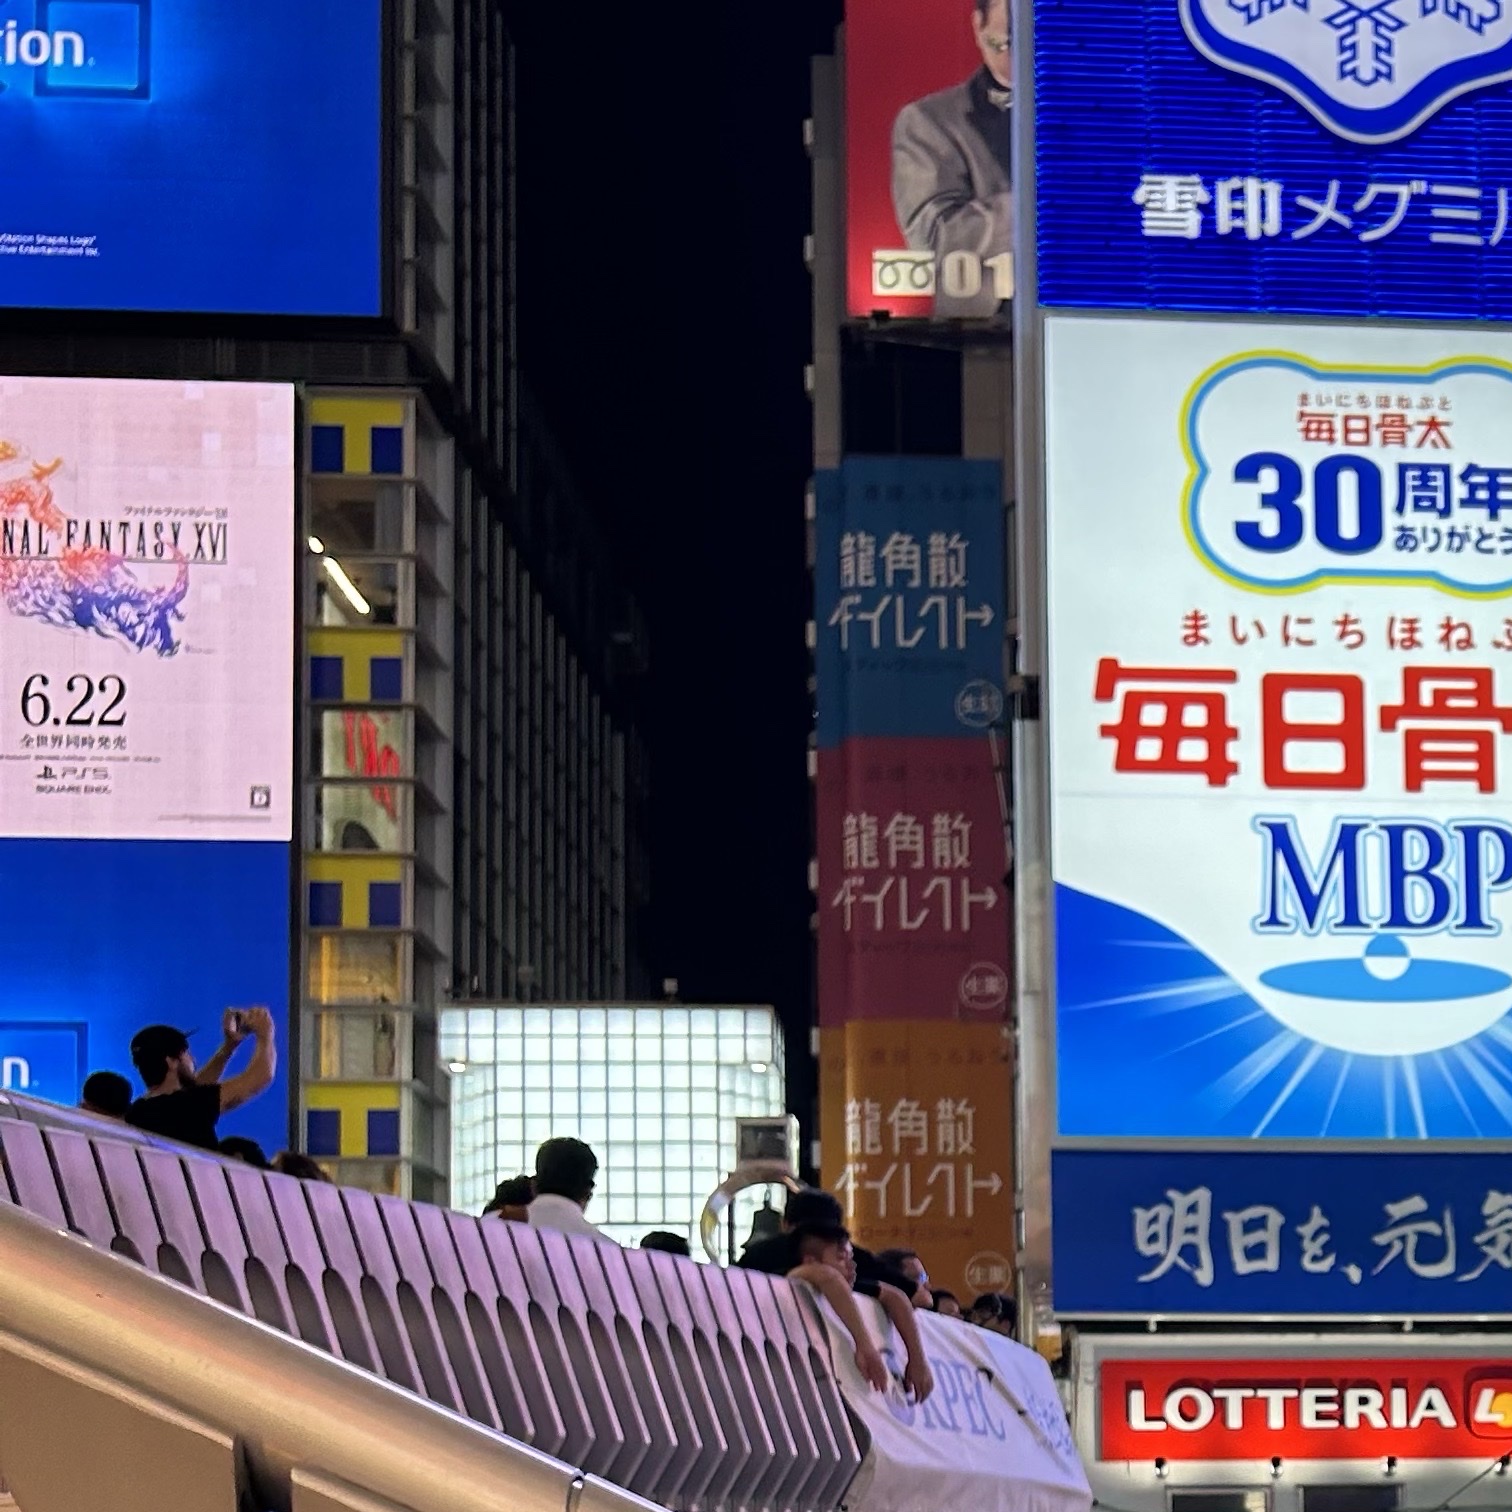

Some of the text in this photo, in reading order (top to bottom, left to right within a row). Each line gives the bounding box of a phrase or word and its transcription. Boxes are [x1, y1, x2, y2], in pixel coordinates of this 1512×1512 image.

[0, 19, 84, 67] ion
[1298, 392, 1453, 411] まいにちほねぶと
[1297, 410, 1453, 450] 毎日骨太
[194, 520, 228, 560] XVI
[840, 531, 969, 588] 龍角散
[828, 594, 995, 650] ダイレクト
[21, 673, 127, 727] 6.22
[843, 812, 973, 869] 龍角散
[832, 876, 998, 932] ダイレクト
[845, 1097, 976, 1155] 龍角散
[834, 1162, 1003, 1218] ダイレクト
[1127, 1387, 1457, 1431] LOTTERIA
